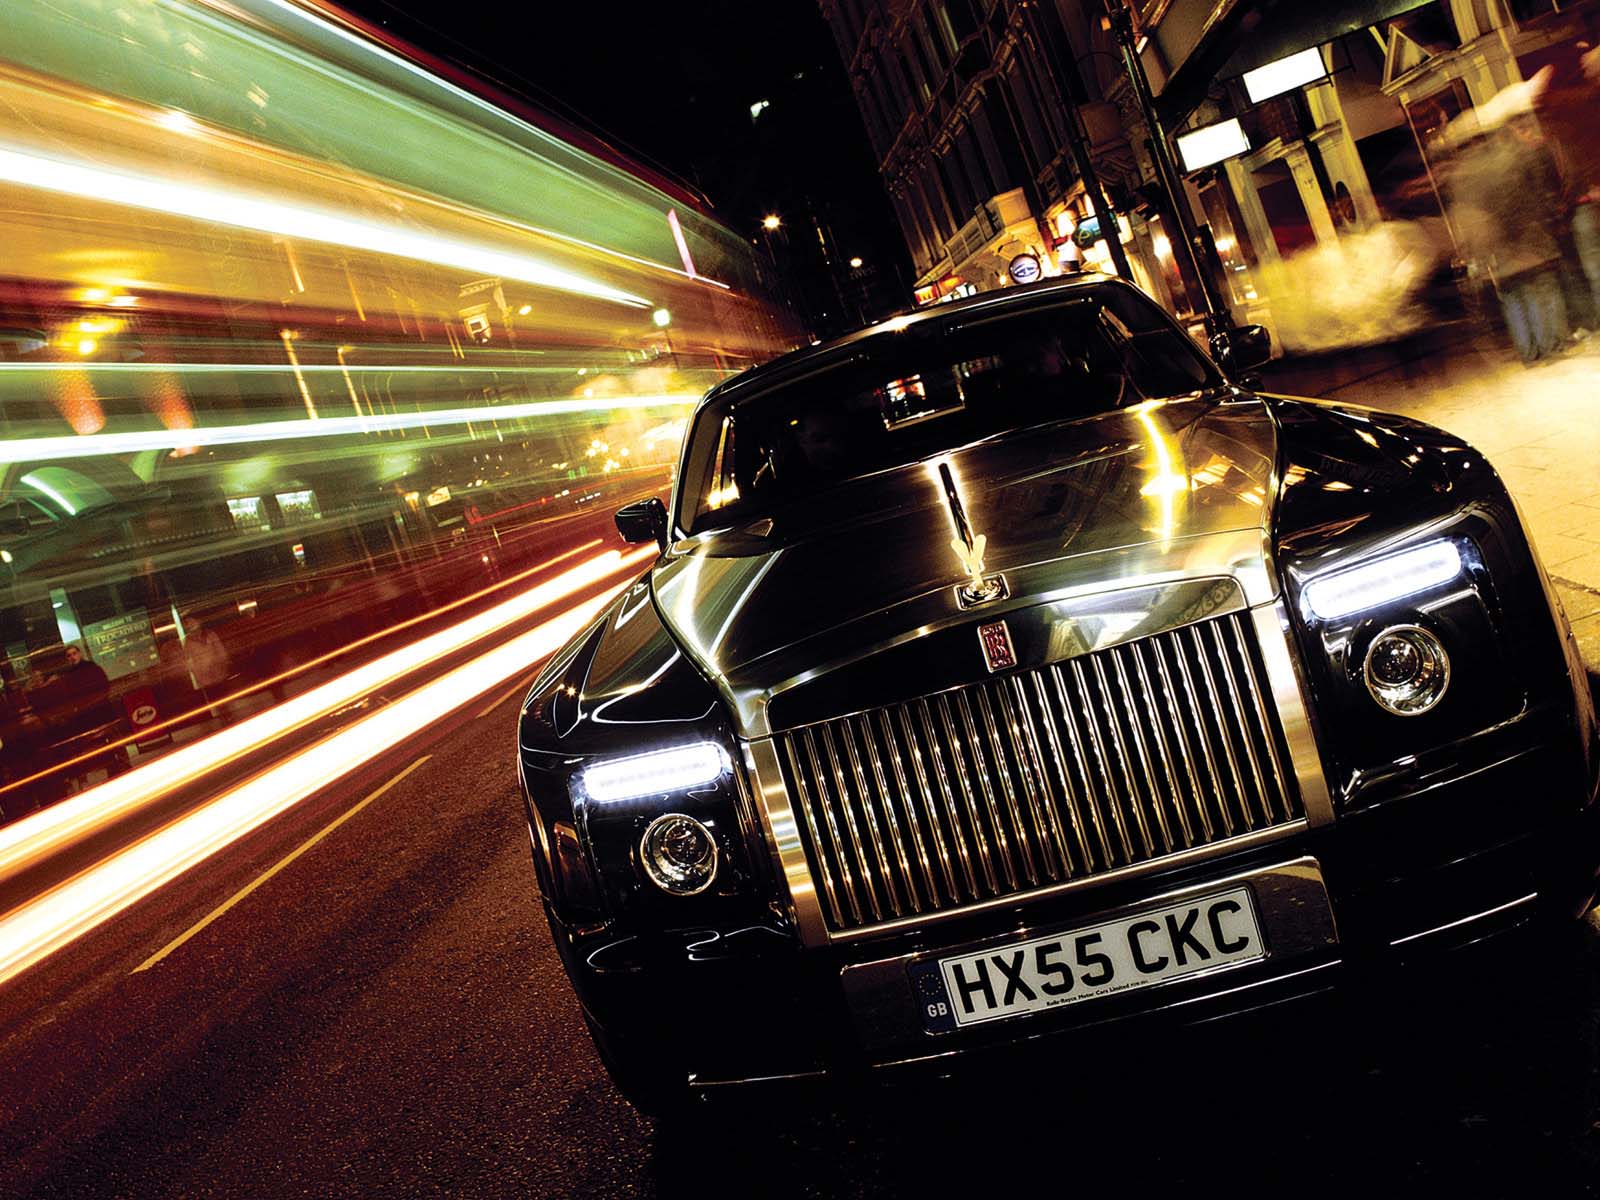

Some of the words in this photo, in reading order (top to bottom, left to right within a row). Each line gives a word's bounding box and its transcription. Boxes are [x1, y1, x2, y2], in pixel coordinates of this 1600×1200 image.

[951, 933, 1115, 1014] HX55
[1126, 899, 1250, 974] CKC
[1095, 988, 1109, 996] Cars
[1109, 983, 1130, 993] Limited
[927, 1001, 948, 1018] GB
